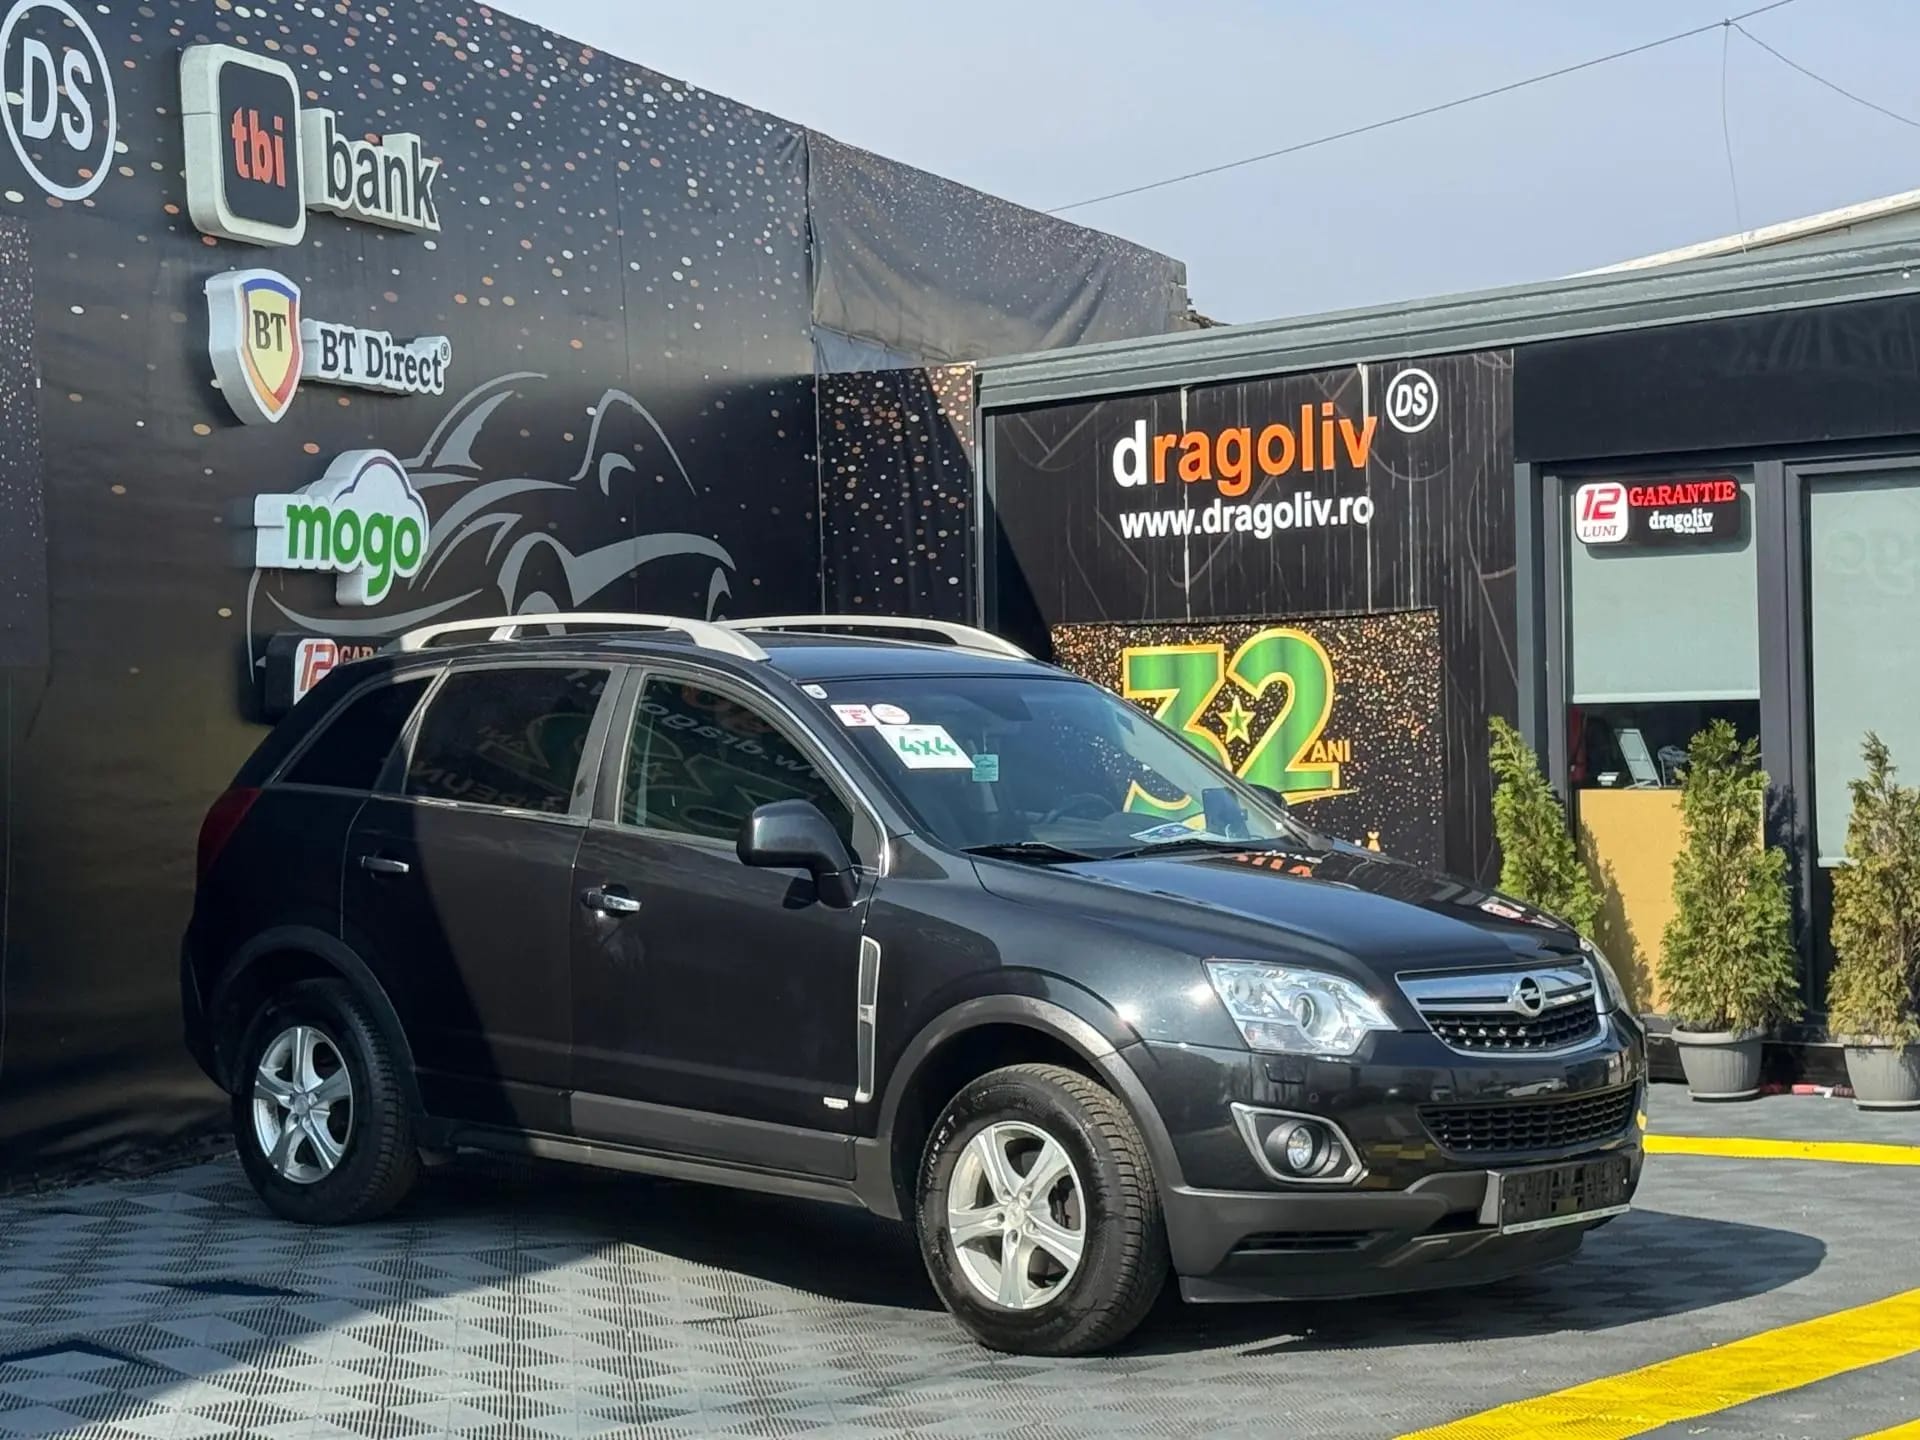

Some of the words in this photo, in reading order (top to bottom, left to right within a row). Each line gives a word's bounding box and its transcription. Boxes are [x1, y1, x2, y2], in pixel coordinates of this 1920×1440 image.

[22, 38, 92, 152] DS
[231, 107, 286, 188] tbi
[325, 116, 441, 232] bank
[253, 310, 287, 352] BT
[320, 328, 356, 375] BT
[1395, 382, 1429, 417] DS
[1112, 401, 1378, 497] dragoliv
[1119, 492, 1375, 540] www.dragoliv.ro
[1582, 488, 1621, 521] 12
[1628, 481, 1736, 506] GARANTIE
[1648, 508, 1714, 533] dragoliv
[286, 503, 421, 597] mogo
[1583, 526, 1618, 538] LUNI
[1310, 739, 1350, 763] ANI
